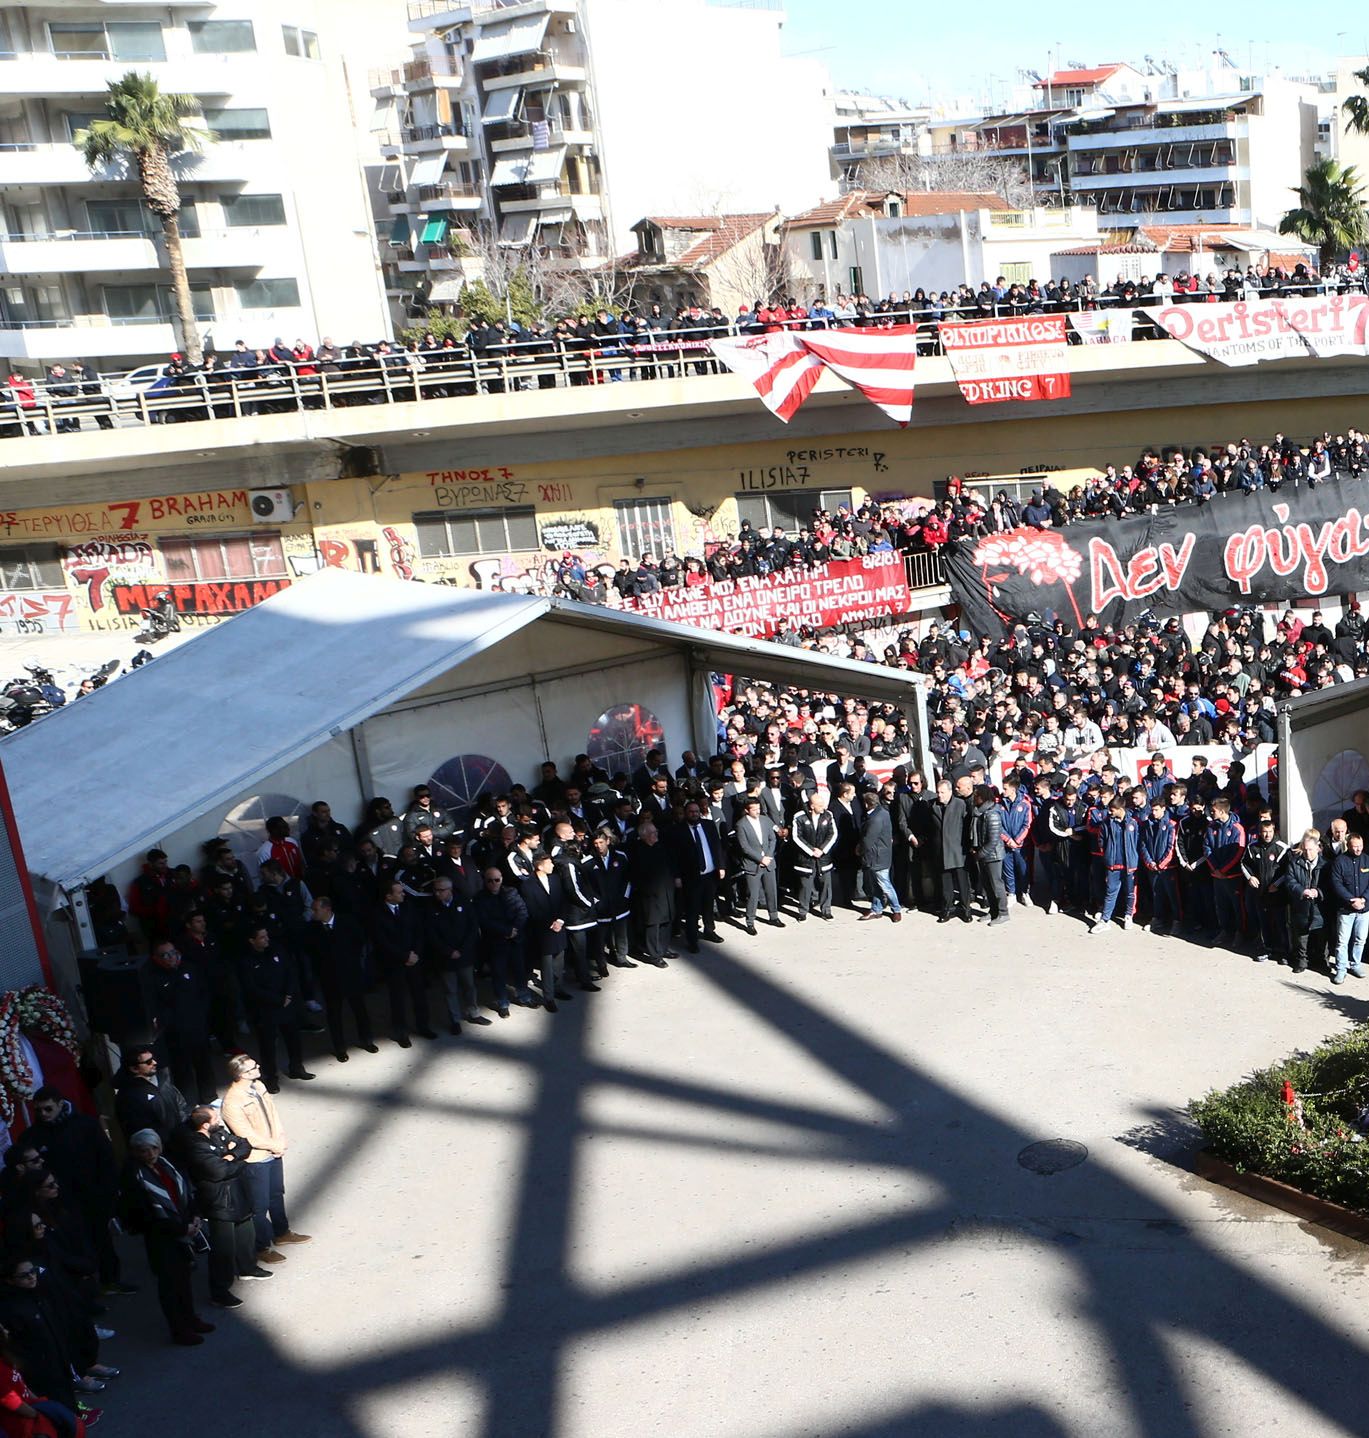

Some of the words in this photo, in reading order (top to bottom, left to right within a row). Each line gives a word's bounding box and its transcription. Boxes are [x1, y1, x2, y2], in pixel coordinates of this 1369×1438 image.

[1269, 337, 1284, 350] OF
[1314, 335, 1345, 347] PORT
[1045, 378, 1055, 394] 7
[426, 470, 495, 486] ΤΗΝΟΣ
[498, 468, 514, 480] 7
[108, 502, 140, 530] 7
[709, 580, 735, 597] ΜΟΥ
[723, 593, 753, 610] ΕΝΑ
[756, 584, 810, 603] ΟΝΕΙΡΟ
[813, 574, 865, 595] ΤΡΕΛΟ
[723, 604, 771, 626] ΔΟΥΝΕ
[775, 603, 801, 617] ΚΑΙ
[802, 599, 816, 613] ΟΙ
[819, 590, 873, 611] ΝΕΚΡΟΙ
[875, 584, 906, 602] ΜΑΣ
[895, 603, 904, 613] 7
[767, 612, 823, 633] ΤΛΙΚΟ
